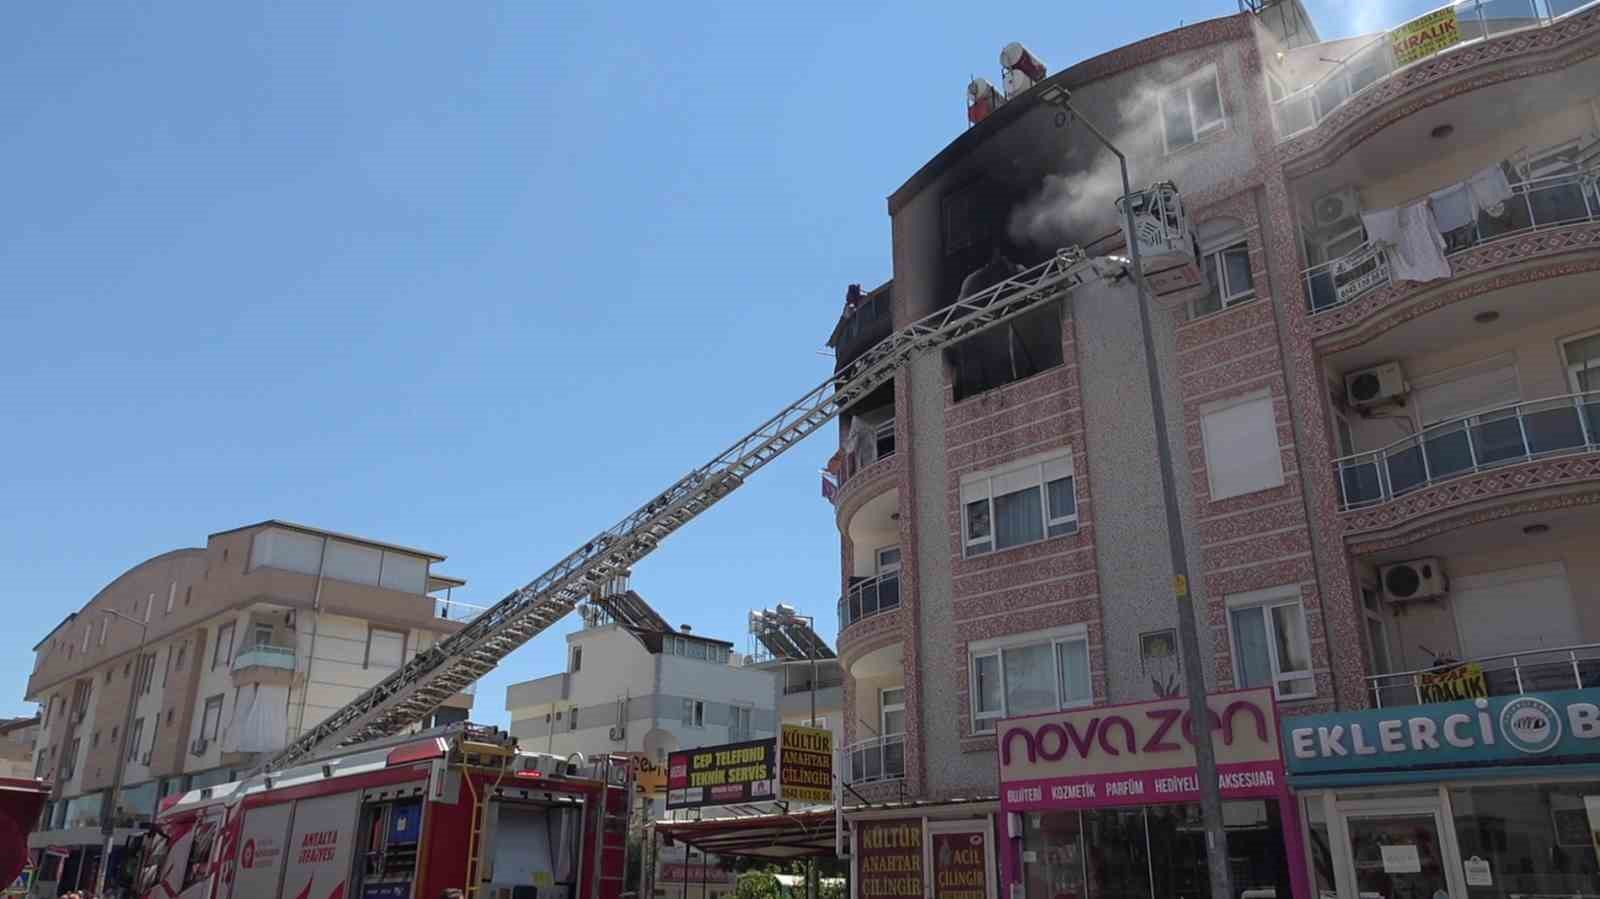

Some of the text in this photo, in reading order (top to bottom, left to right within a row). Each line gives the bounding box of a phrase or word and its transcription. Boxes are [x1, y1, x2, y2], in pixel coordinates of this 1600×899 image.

[784, 730, 831, 752] KÜLTÜR
[693, 746, 765, 769] CEP TELEFONU
[784, 751, 831, 768] ANAHTAR
[690, 768, 726, 786] TEKNİK
[727, 763, 768, 783] SERVİS
[1105, 778, 1144, 797] PARFÜM
[1218, 770, 1275, 789] AKSESUAR
[303, 829, 338, 846] ANTALYA
[863, 824, 921, 849] KÜLTÜR
[863, 855, 921, 873] ANAHTAR
